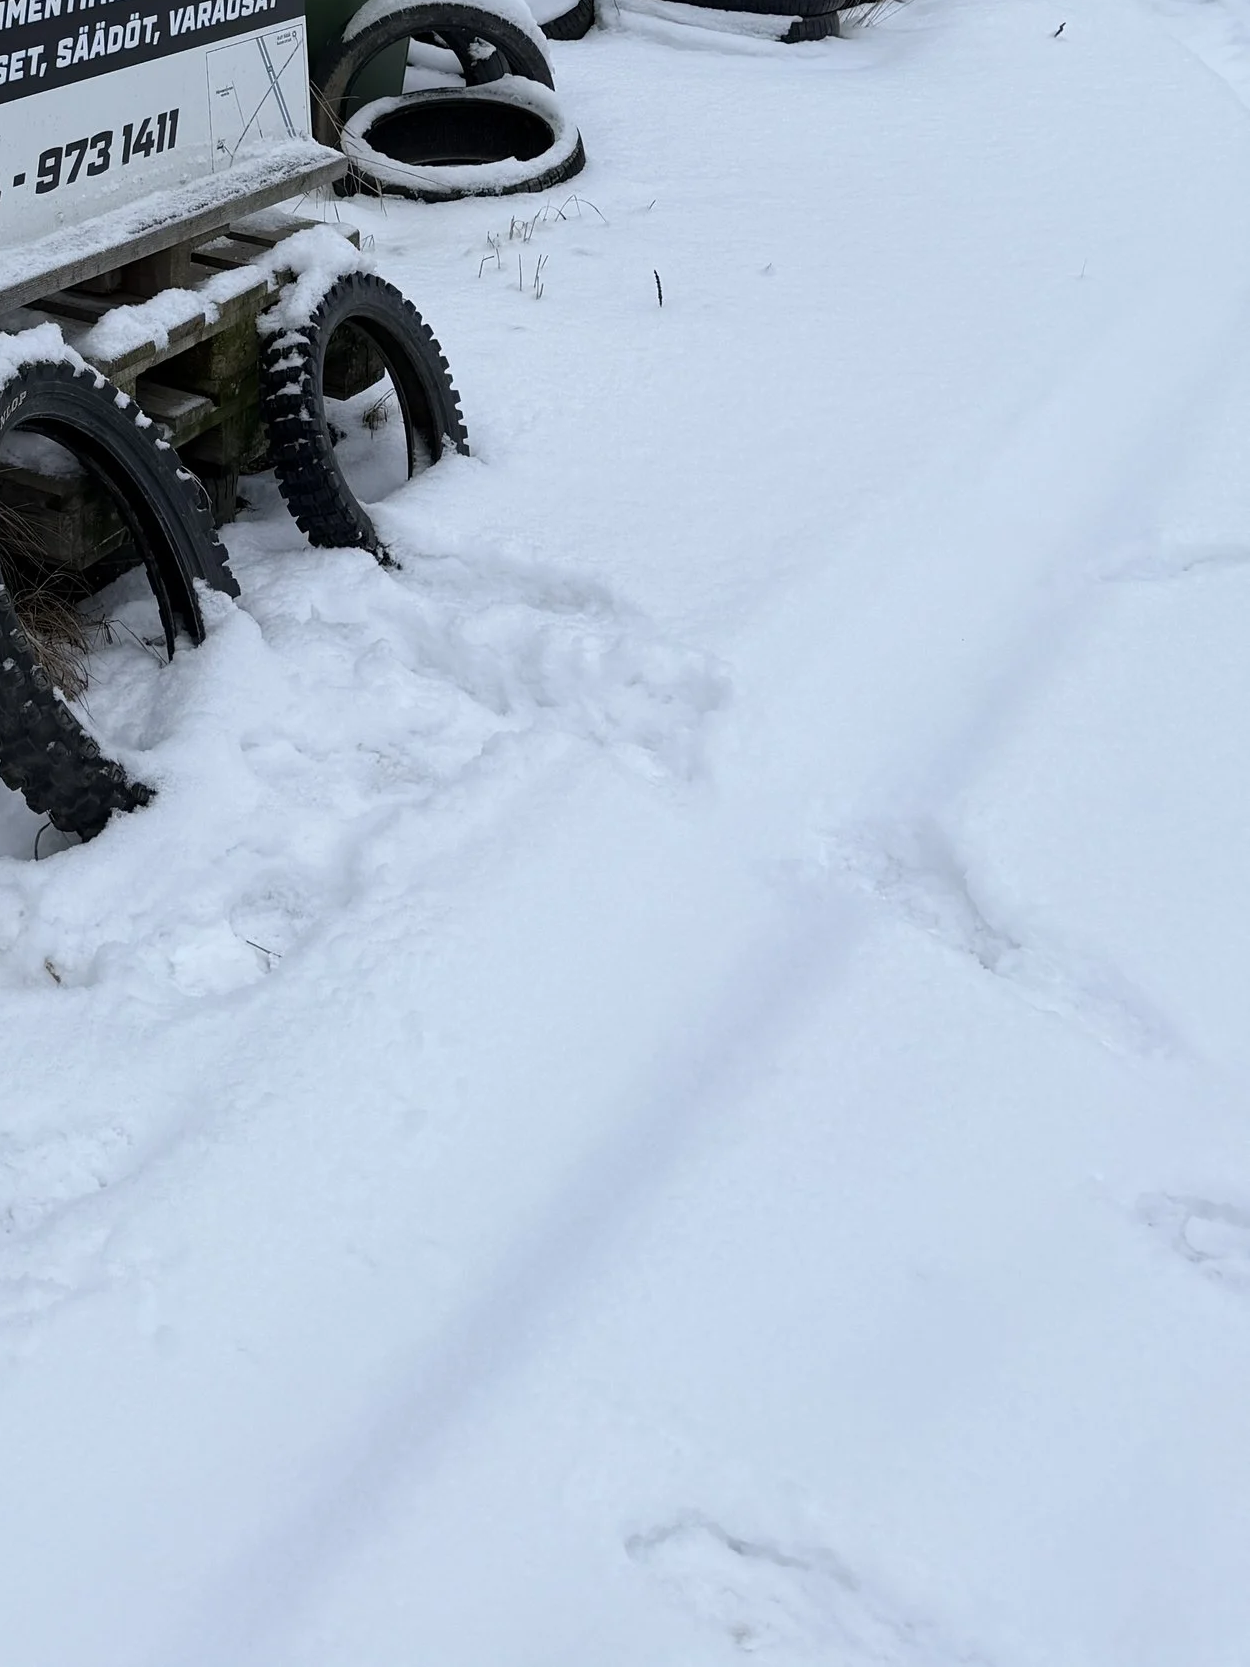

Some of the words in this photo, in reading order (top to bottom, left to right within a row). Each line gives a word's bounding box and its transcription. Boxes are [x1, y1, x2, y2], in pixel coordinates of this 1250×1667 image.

[55, 11, 161, 69] SÄÄDÖT,
[35, 130, 114, 195] 973
[121, 108, 180, 165] 1411
